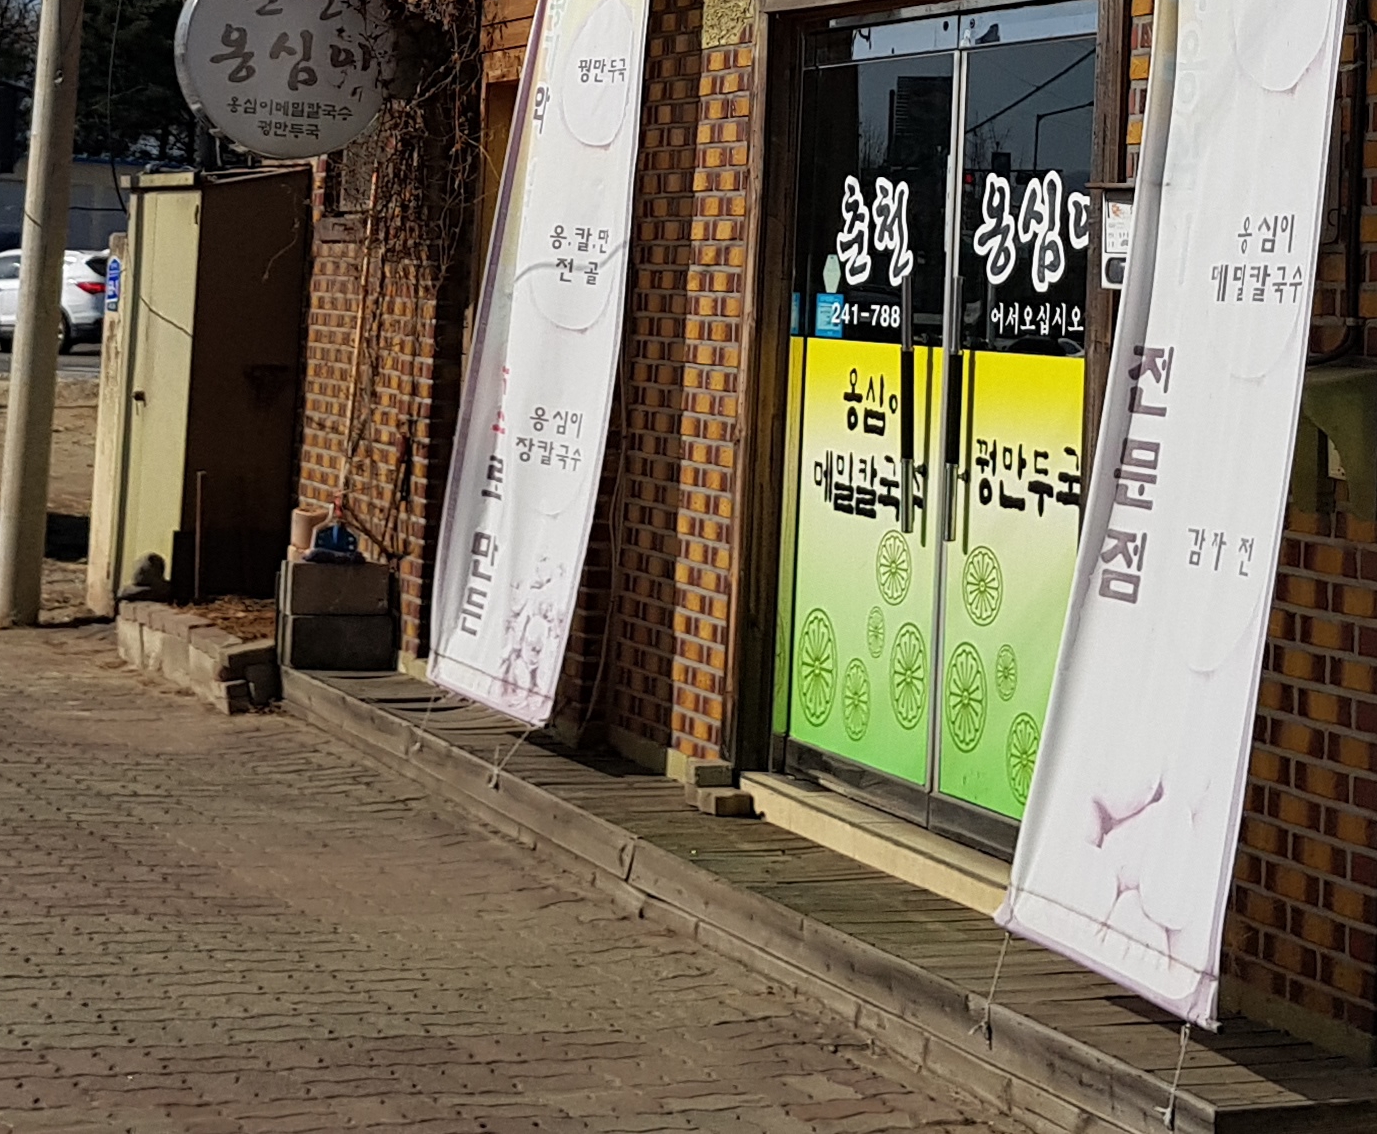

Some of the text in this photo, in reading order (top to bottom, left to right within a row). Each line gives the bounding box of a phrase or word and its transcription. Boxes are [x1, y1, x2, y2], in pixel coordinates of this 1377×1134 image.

[836, 174, 914, 287] 춘천
[1237, 214, 1296, 254] 옹심이
[1210, 264, 1303, 304] 메밀칼국수
[831, 302, 901, 329] 241-788
[990, 301, 1085, 336] 어서오십시오
[529, 406, 583, 439] 옹심이
[515, 436, 582, 472] 장칼국수
[1098, 345, 1175, 605] 전문점
